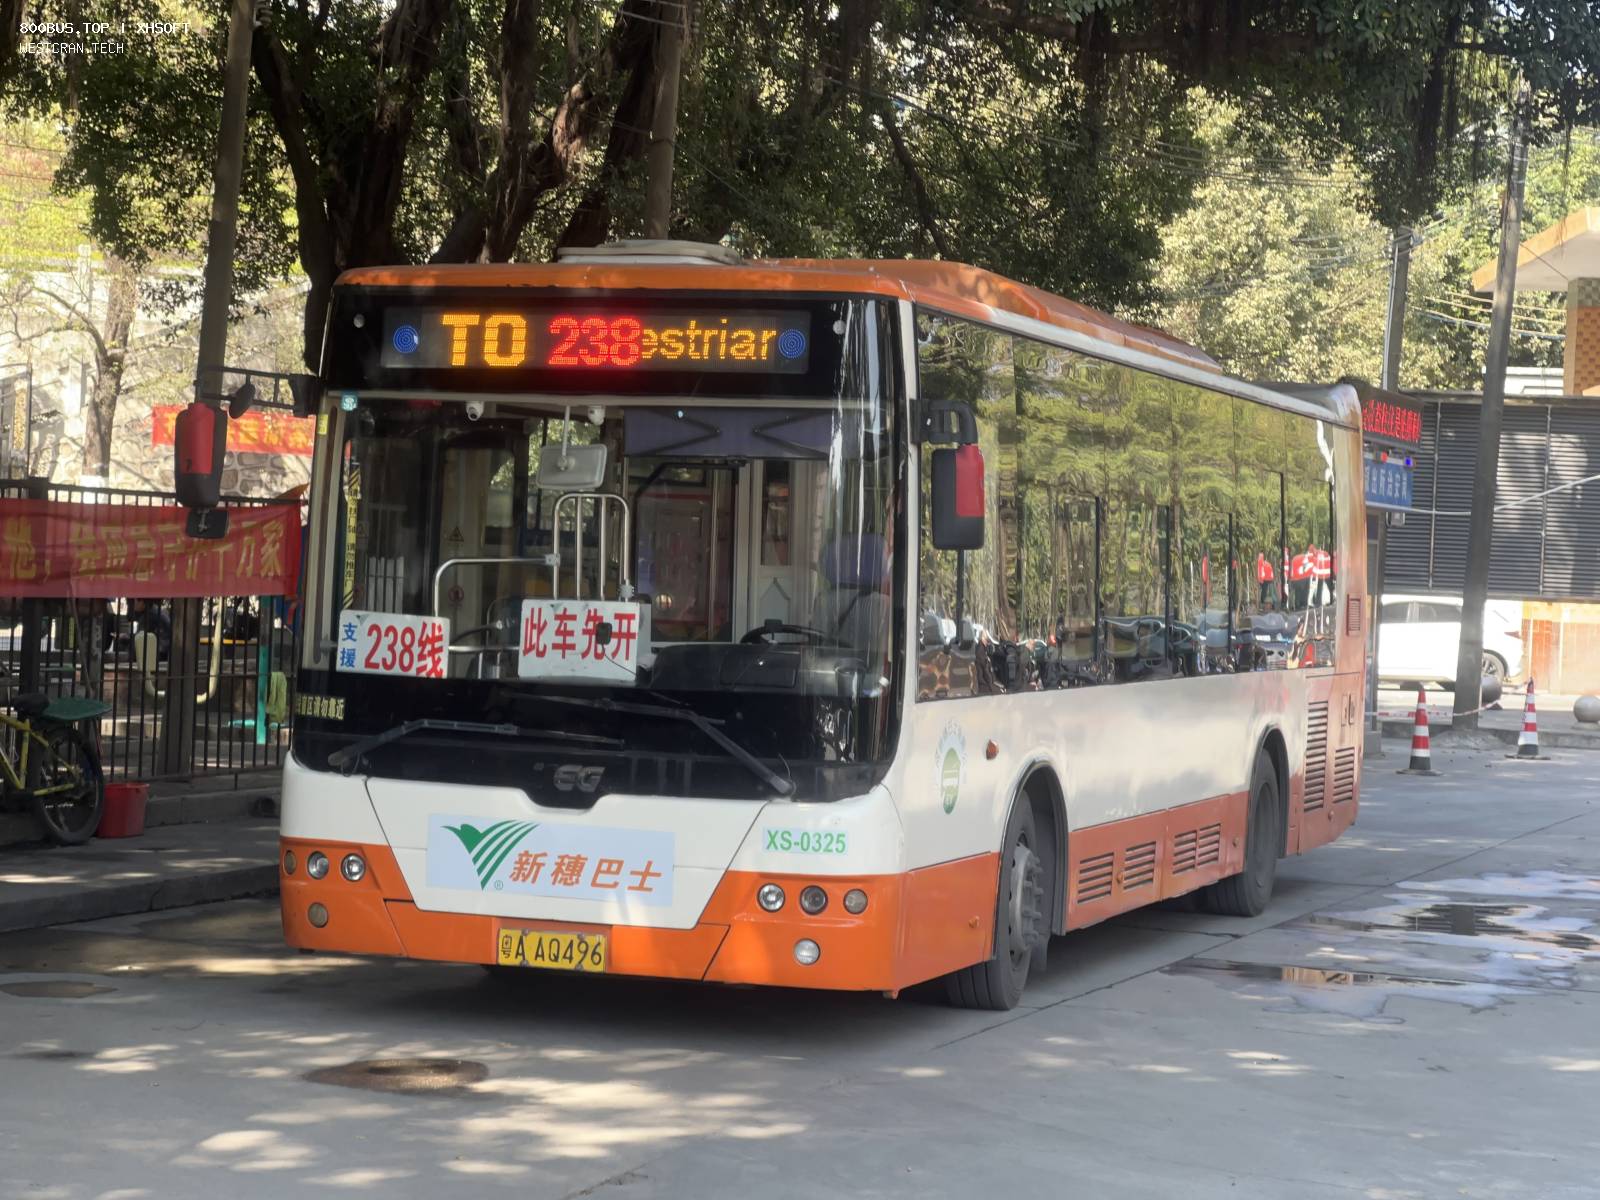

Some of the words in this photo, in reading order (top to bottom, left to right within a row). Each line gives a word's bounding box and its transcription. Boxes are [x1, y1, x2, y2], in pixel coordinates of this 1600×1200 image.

[442, 314, 527, 367] TO
[548, 316, 642, 366] 238
[340, 621, 357, 669] 支援
[364, 621, 446, 679] 238线
[522, 606, 636, 662] 此车先开
[766, 829, 846, 853] XS-0325
[509, 850, 662, 892] 新穗巴士
